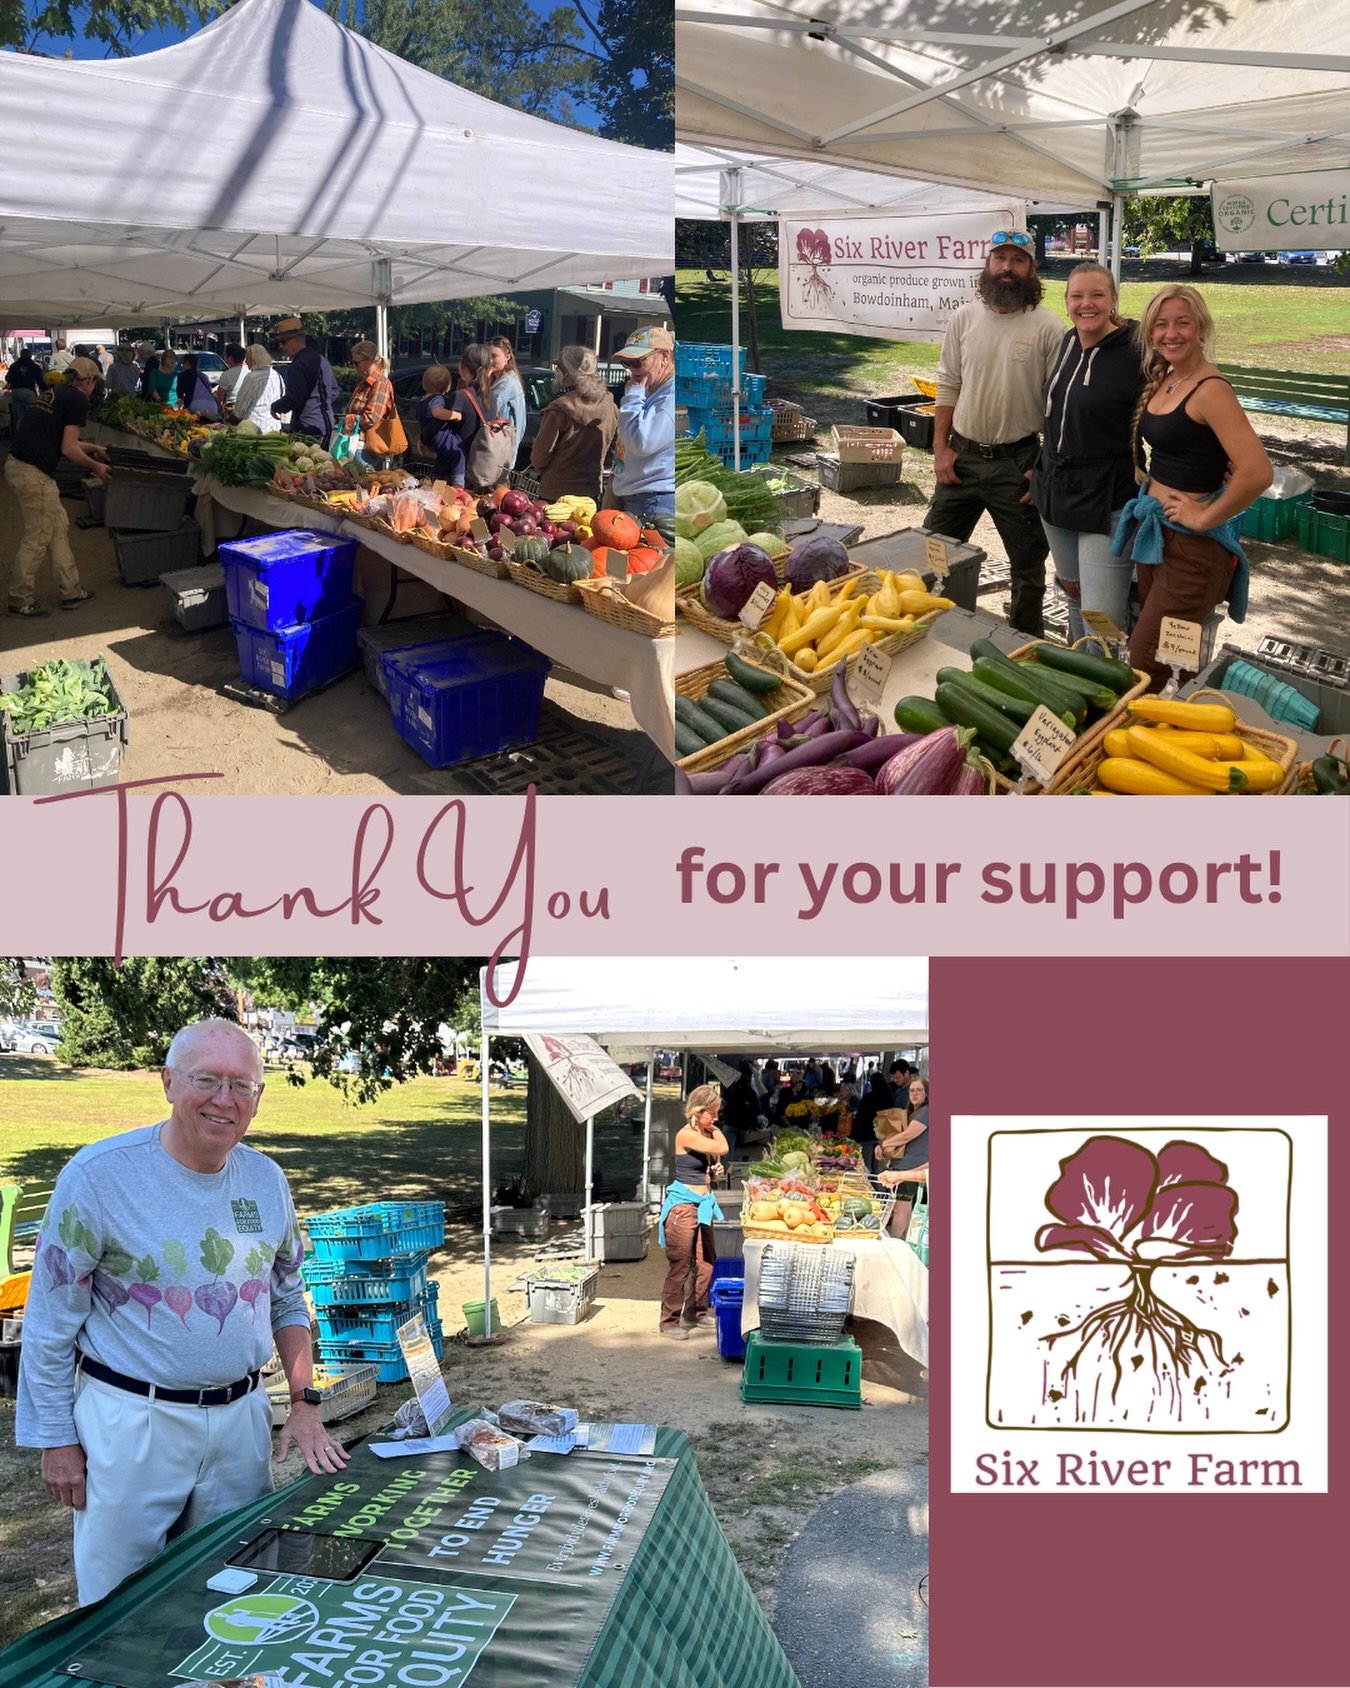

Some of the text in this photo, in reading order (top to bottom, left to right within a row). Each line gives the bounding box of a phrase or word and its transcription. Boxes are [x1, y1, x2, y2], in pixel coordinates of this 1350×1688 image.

[1218, 209, 1255, 217] ORGANIC
[1267, 194, 1347, 227] Certi
[834, 235, 863, 259] Six
[870, 234, 928, 261] River
[852, 273, 887, 286] organic
[889, 274, 929, 288] produce
[932, 277, 966, 289] grown
[853, 292, 934, 311] Bowdoinham,
[239, 1224, 262, 1232] EQUITY
[427, 1496, 501, 1558] TO END
[481, 1493, 557, 1565] HUNGER
[373, 1590, 446, 1644] FOOD
[387, 1593, 498, 1688] QUITY
[204, 1650, 248, 1676] EST.
